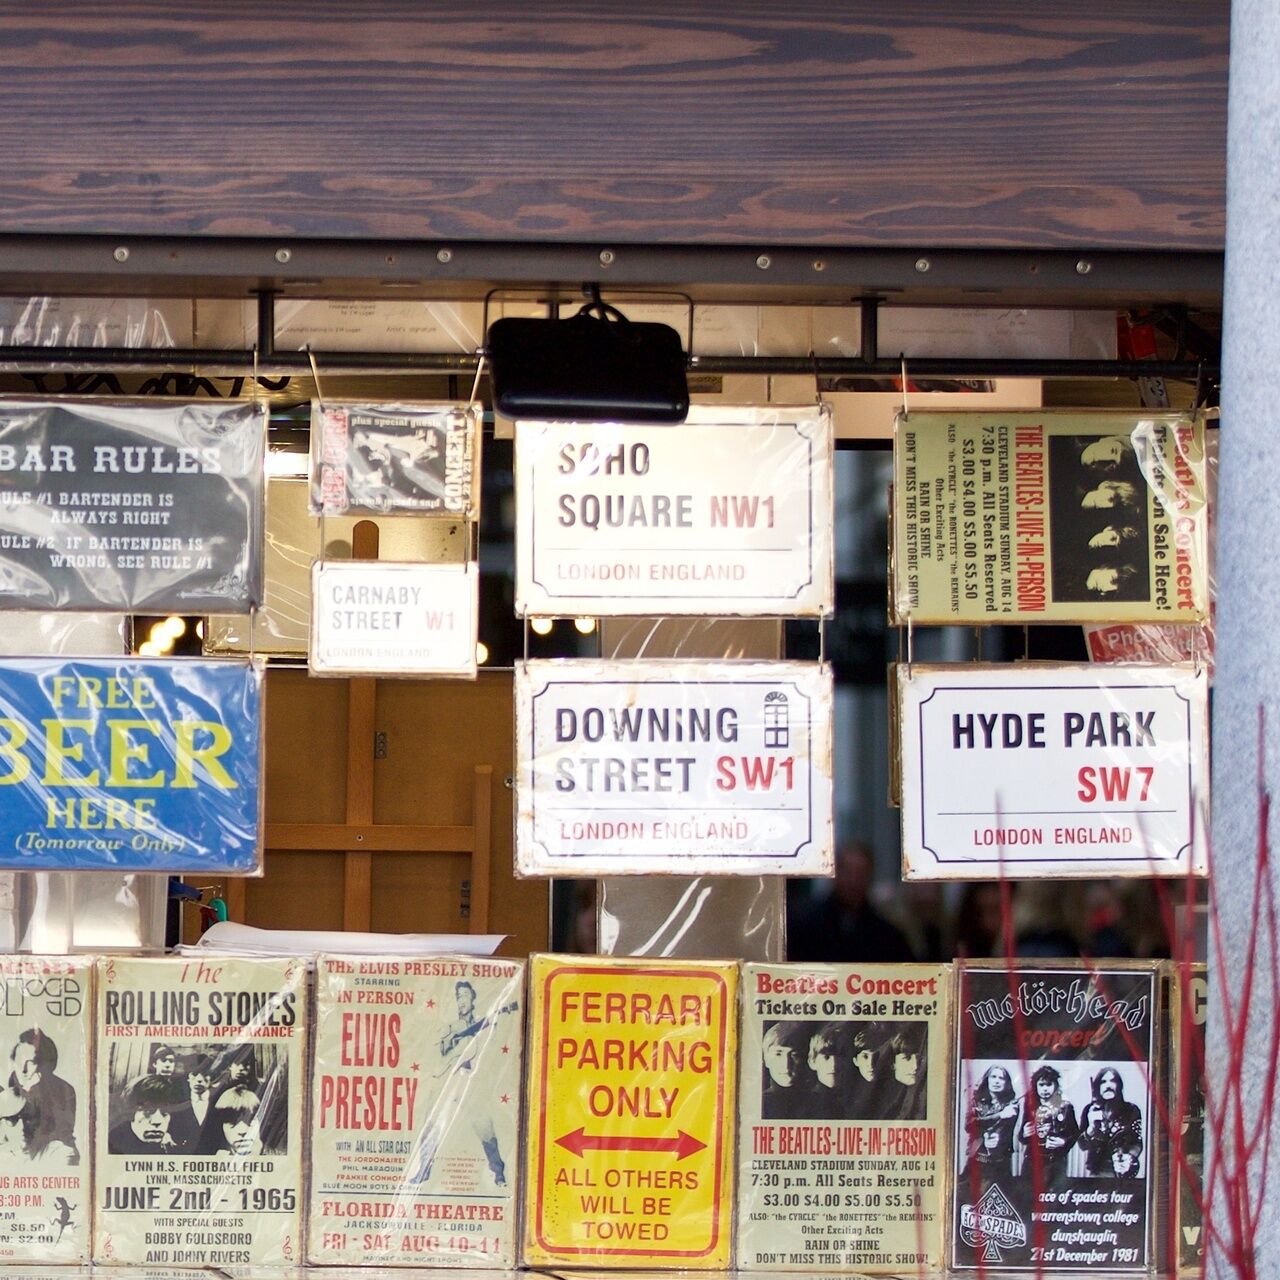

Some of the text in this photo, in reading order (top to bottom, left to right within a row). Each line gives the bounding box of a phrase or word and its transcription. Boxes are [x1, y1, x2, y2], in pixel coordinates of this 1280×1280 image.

[351, 416, 441, 428] plus special guests
[1016, 425, 1043, 448] THE
[94, 446, 221, 473] RULES
[445, 414, 465, 510] CONCERT
[558, 443, 650, 475] SOHO
[36, 493, 53, 505] #1
[60, 493, 152, 507] BARTENDER
[158, 494, 174, 507] IS
[51, 511, 170, 525] ALWAYS RIGHT
[558, 494, 775, 530] SQUARE NW1
[1175, 426, 1196, 611] Beatles Concert
[36, 537, 55, 549] #2
[66, 537, 82, 549] IF
[89, 537, 183, 551] BARTENDER
[189, 538, 203, 551] IS
[1153, 524, 1169, 560] Sale
[117, 556, 144, 569] SEE
[151, 556, 191, 570] RULE
[197, 556, 212, 570] #1
[557, 564, 745, 581] LONDON ENGLAND
[332, 585, 422, 605] CARNABY
[1154, 564, 1171, 611] Here!
[332, 611, 455, 631] STREET W1
[52, 677, 157, 709] FREE
[555, 707, 738, 742] DOWNING
[952, 711, 1156, 749] HYDE PARK
[556, 756, 795, 793] STREET SW1
[1077, 766, 1154, 803] SW7
[46, 798, 157, 830] HERE
[15, 832, 125, 851] (Tomorrow
[561, 822, 748, 840] LONDON ENGLAND
[974, 827, 1132, 845] LONDON ENGLAND
[325, 960, 516, 978] THE ELVIS PRESLEY SHOW
[354, 978, 400, 986] STARRING
[756, 973, 937, 995] Beatles Concert
[106, 990, 296, 1026] ROLLING STONES
[337, 990, 414, 1005] IN PERSON
[755, 1000, 937, 1016] Tickets On Sale Here!
[561, 992, 712, 1026] FERRARI
[105, 1026, 294, 1037] FIRST AMERICAN APPRANCE
[341, 1012, 401, 1068] ELVIS
[557, 1038, 712, 1073] PARKING
[320, 1075, 418, 1131] PRESLEY
[589, 1085, 679, 1119] ONLY
[752, 1126, 775, 1154] THE
[13, 1177, 38, 1189] ARTS
[42, 1177, 80, 1189] CENTER
[555, 1168, 699, 1190] ALL OTHERS
[102, 1187, 161, 1209] JUNE
[169, 1187, 211, 1210] 2nd
[239, 1188, 296, 1210] 1965
[581, 1196, 671, 1216] WILL BE
[1039, 1190, 1133, 1206] ace of spades tour
[323, 1202, 504, 1221] FLORIDA THEATRE
[1103, 1212, 1139, 1225] college
[583, 1221, 669, 1241] TOWED
[985, 1217, 1024, 1237] SPADES
[1031, 1248, 1138, 1264] 21st December 1981
